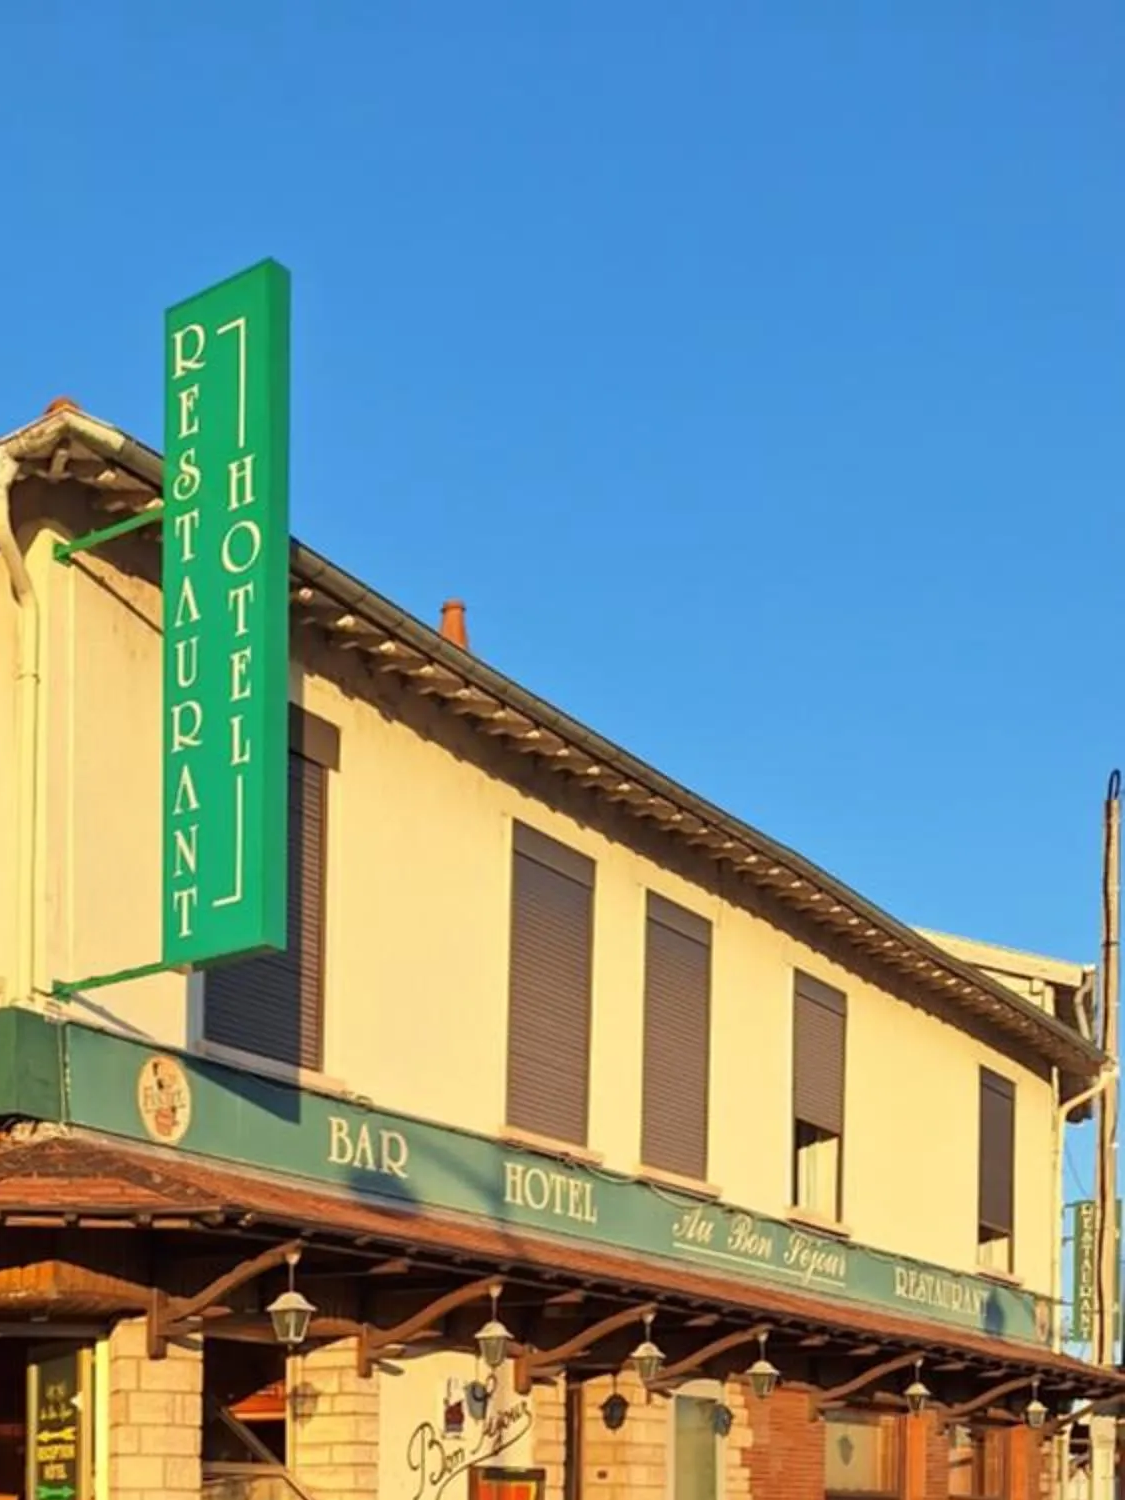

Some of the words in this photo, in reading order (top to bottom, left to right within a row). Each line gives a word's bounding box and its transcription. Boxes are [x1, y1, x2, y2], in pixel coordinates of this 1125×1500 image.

[171, 322, 205, 938] RESTAURANT
[219, 453, 262, 767] HOTEL
[328, 1116, 409, 1179] BAR
[504, 1161, 597, 1225] HOTEL
[672, 1205, 716, 1244] Au
[727, 1213, 773, 1261] Bon
[894, 1265, 989, 1317] RESTAURANT
